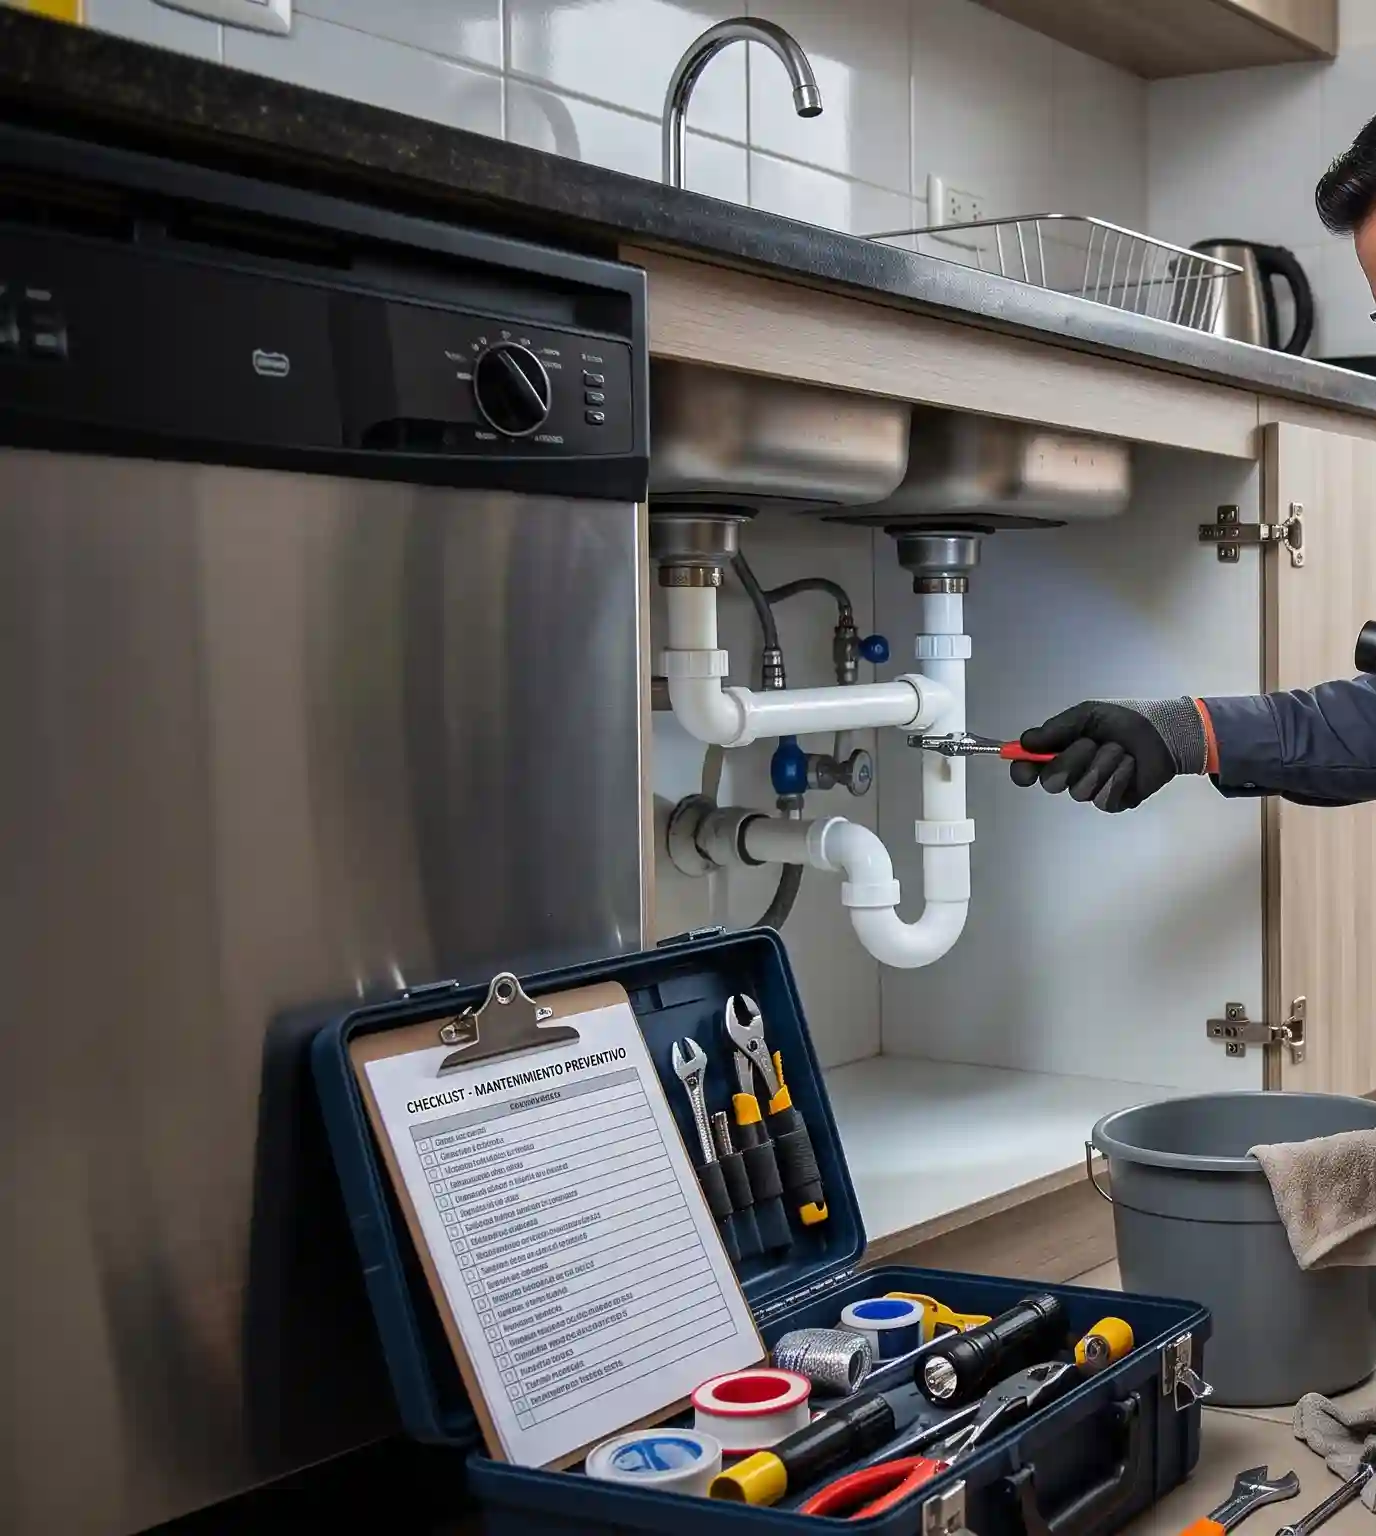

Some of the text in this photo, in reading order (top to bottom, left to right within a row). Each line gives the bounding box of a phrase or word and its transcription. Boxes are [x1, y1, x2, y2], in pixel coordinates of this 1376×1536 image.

[406, 1088, 465, 1114] CHECKLIST
[474, 1063, 563, 1097] MANTENIMIENTO
[565, 1047, 627, 1073] PREVENTIVO
